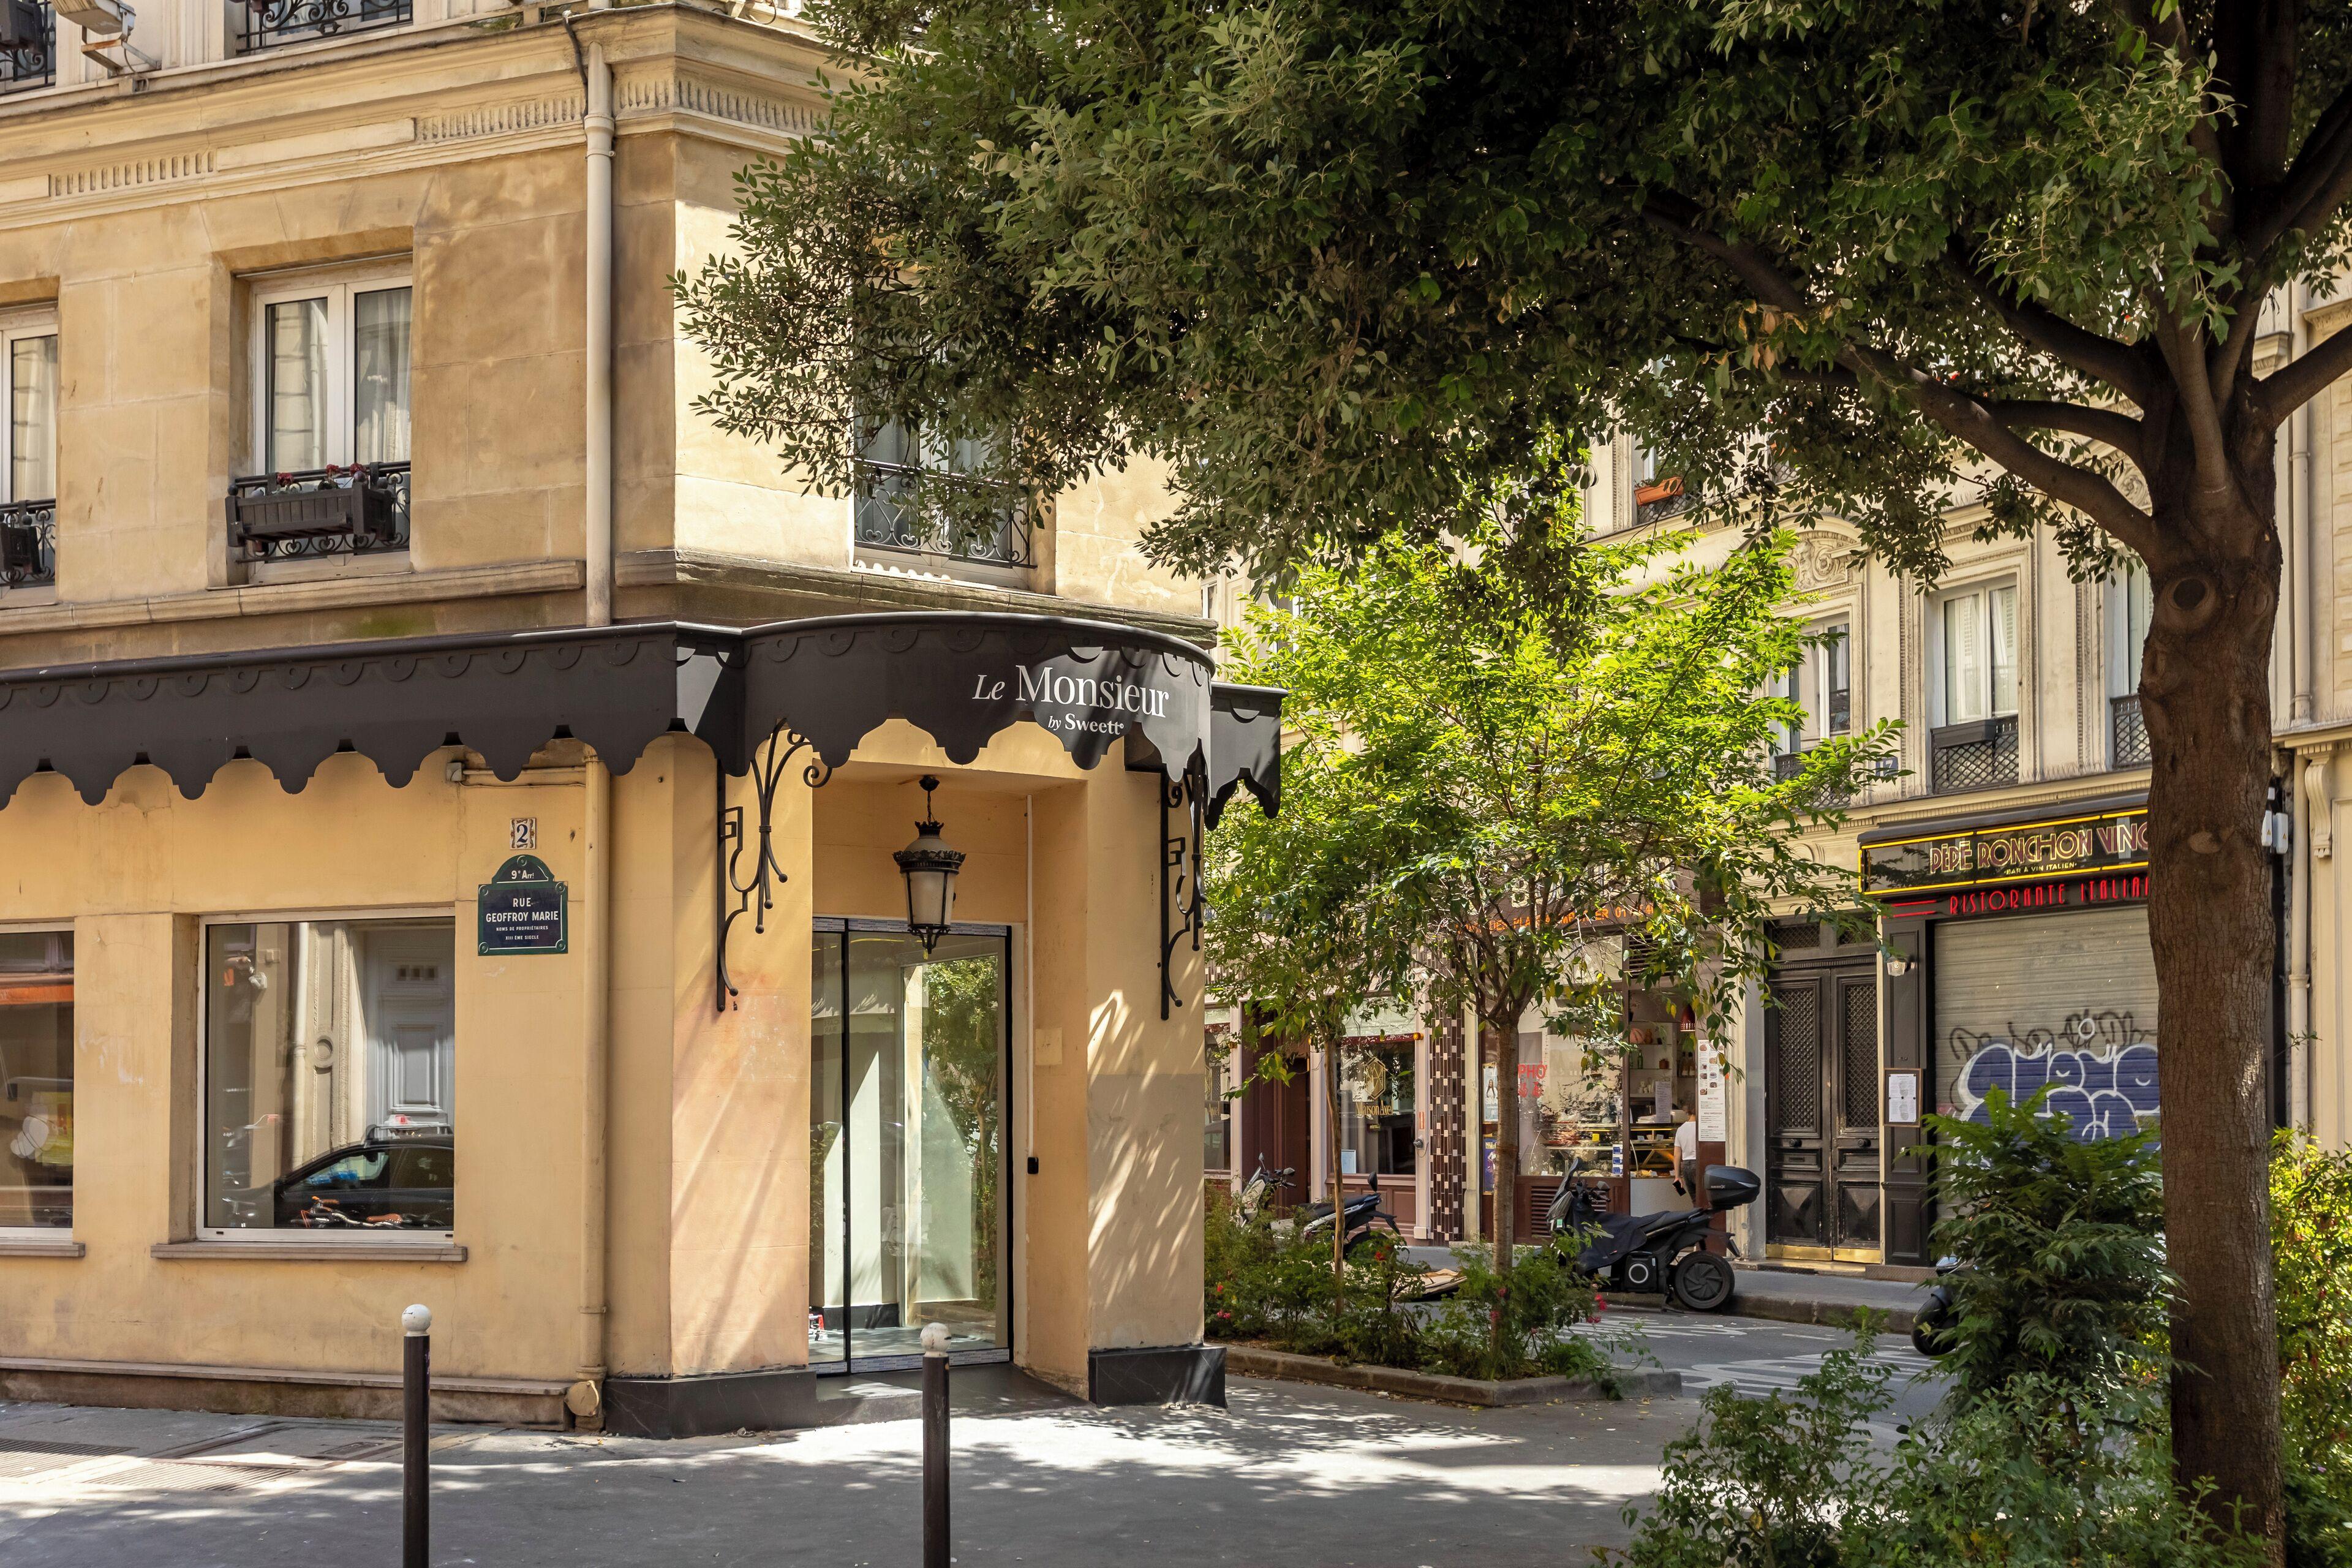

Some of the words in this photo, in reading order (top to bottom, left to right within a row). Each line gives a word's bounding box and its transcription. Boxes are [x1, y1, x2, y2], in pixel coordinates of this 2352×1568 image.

[972, 674, 1006, 701] Le
[1016, 665, 1169, 718] Monsieur
[1048, 715, 1061, 731] by
[1880, 760, 1893, 777] 17
[516, 824, 528, 843] 2
[1977, 829, 2093, 869] RONCHON
[2046, 862, 2075, 870] ITALIEN
[513, 897, 532, 907] RUE
[1950, 884, 2065, 914] RISTORANTE
[486, 911, 529, 922] GEOFFROY
[532, 911, 559, 921] MARIE
[1355, 1101, 1379, 1115] Maison
[1380, 1099, 1393, 1115] Axel
